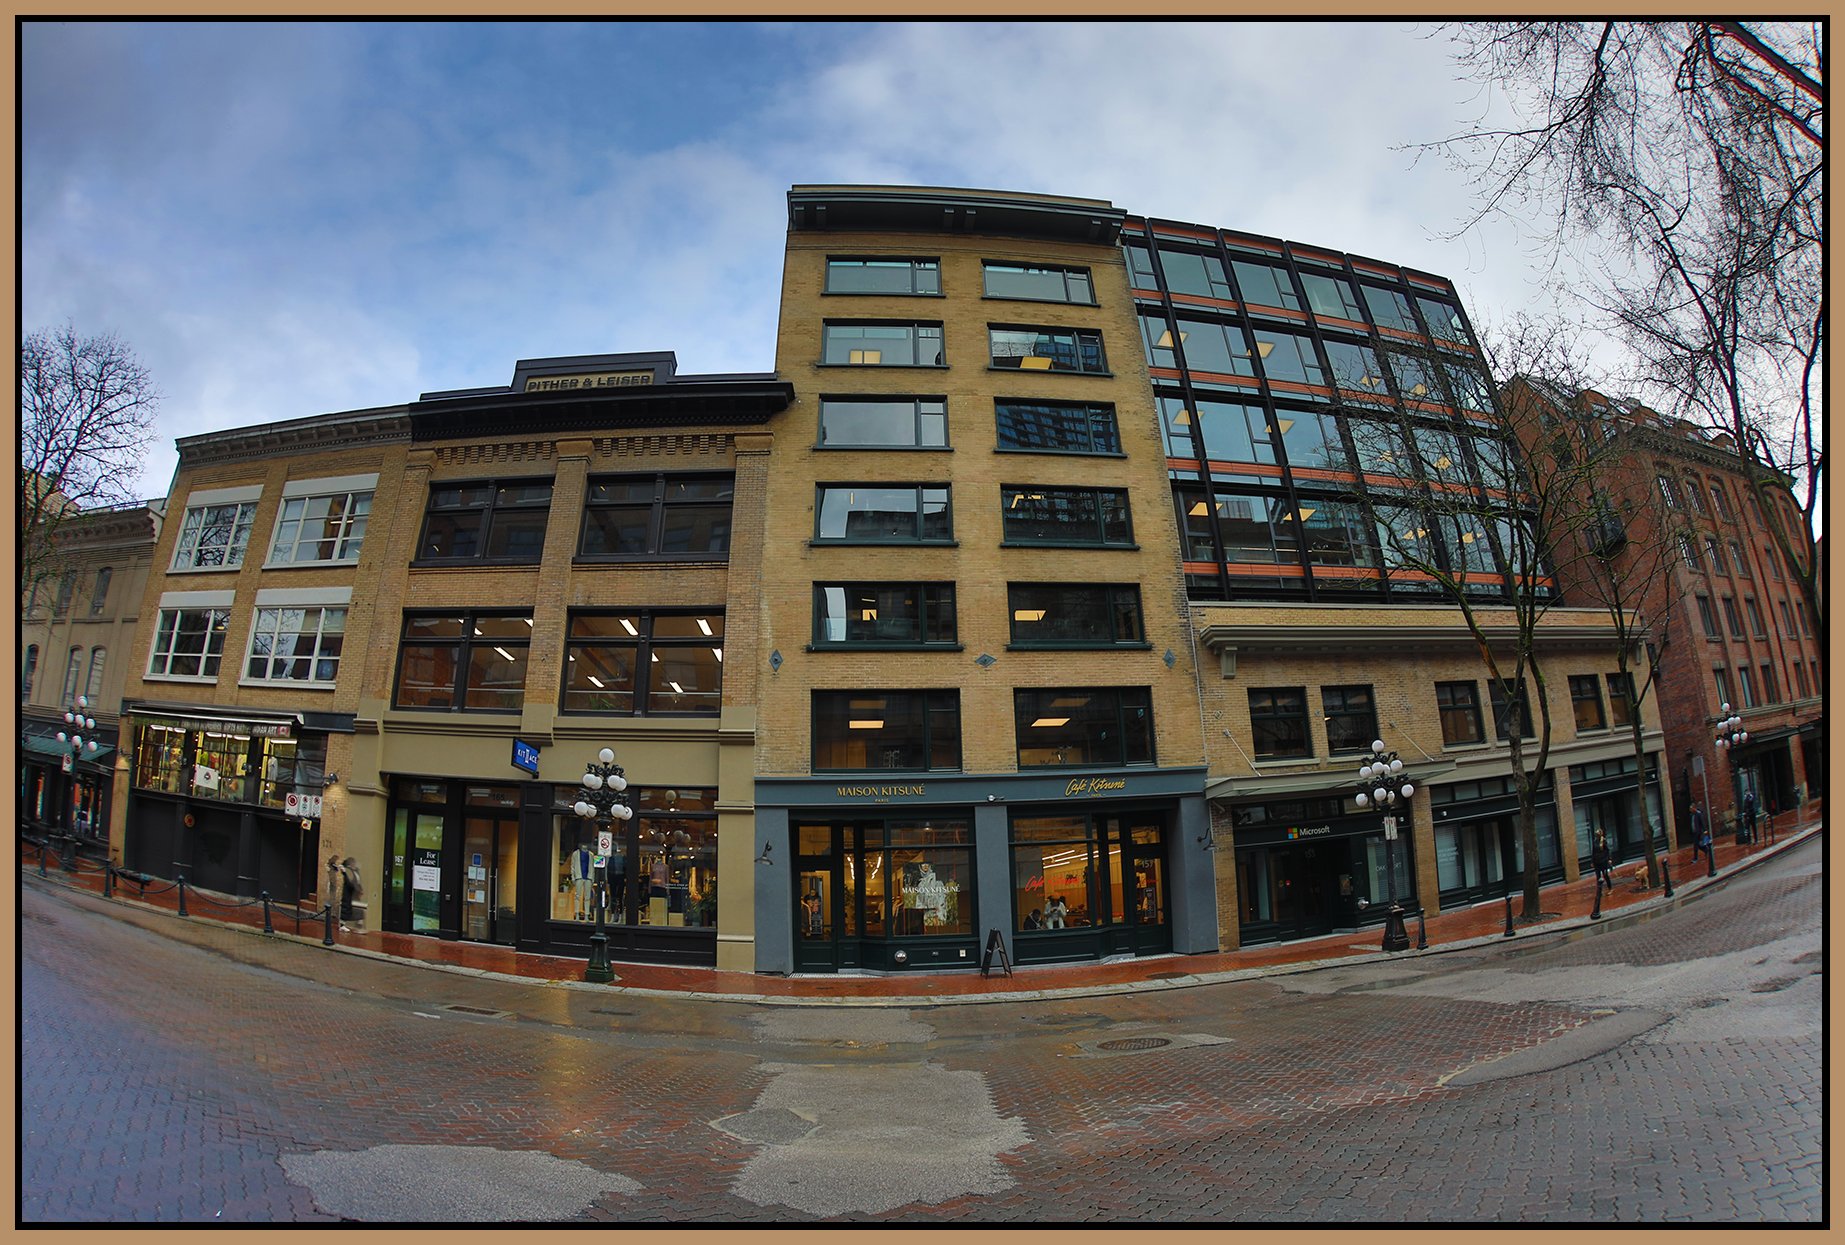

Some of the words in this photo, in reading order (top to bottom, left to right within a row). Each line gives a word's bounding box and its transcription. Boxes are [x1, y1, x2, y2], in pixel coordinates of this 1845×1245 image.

[528, 378, 579, 391] PITHER
[582, 377, 593, 387] &
[597, 374, 650, 386] LEISER
[517, 748, 526, 758] KIT
[529, 754, 538, 764] ACE
[837, 786, 879, 797] MAISON
[881, 783, 926, 795] KITSUNÉ
[1065, 779, 1087, 796] Café
[1088, 778, 1126, 792] Kitsuné
[1300, 825, 1330, 836] Microsoft
[426, 851, 437, 859] For
[419, 857, 437, 866] Lease
[1142, 859, 1154, 869] 157
[902, 886, 930, 894] MAISON
[930, 883, 961, 893] KITSUNÉ
